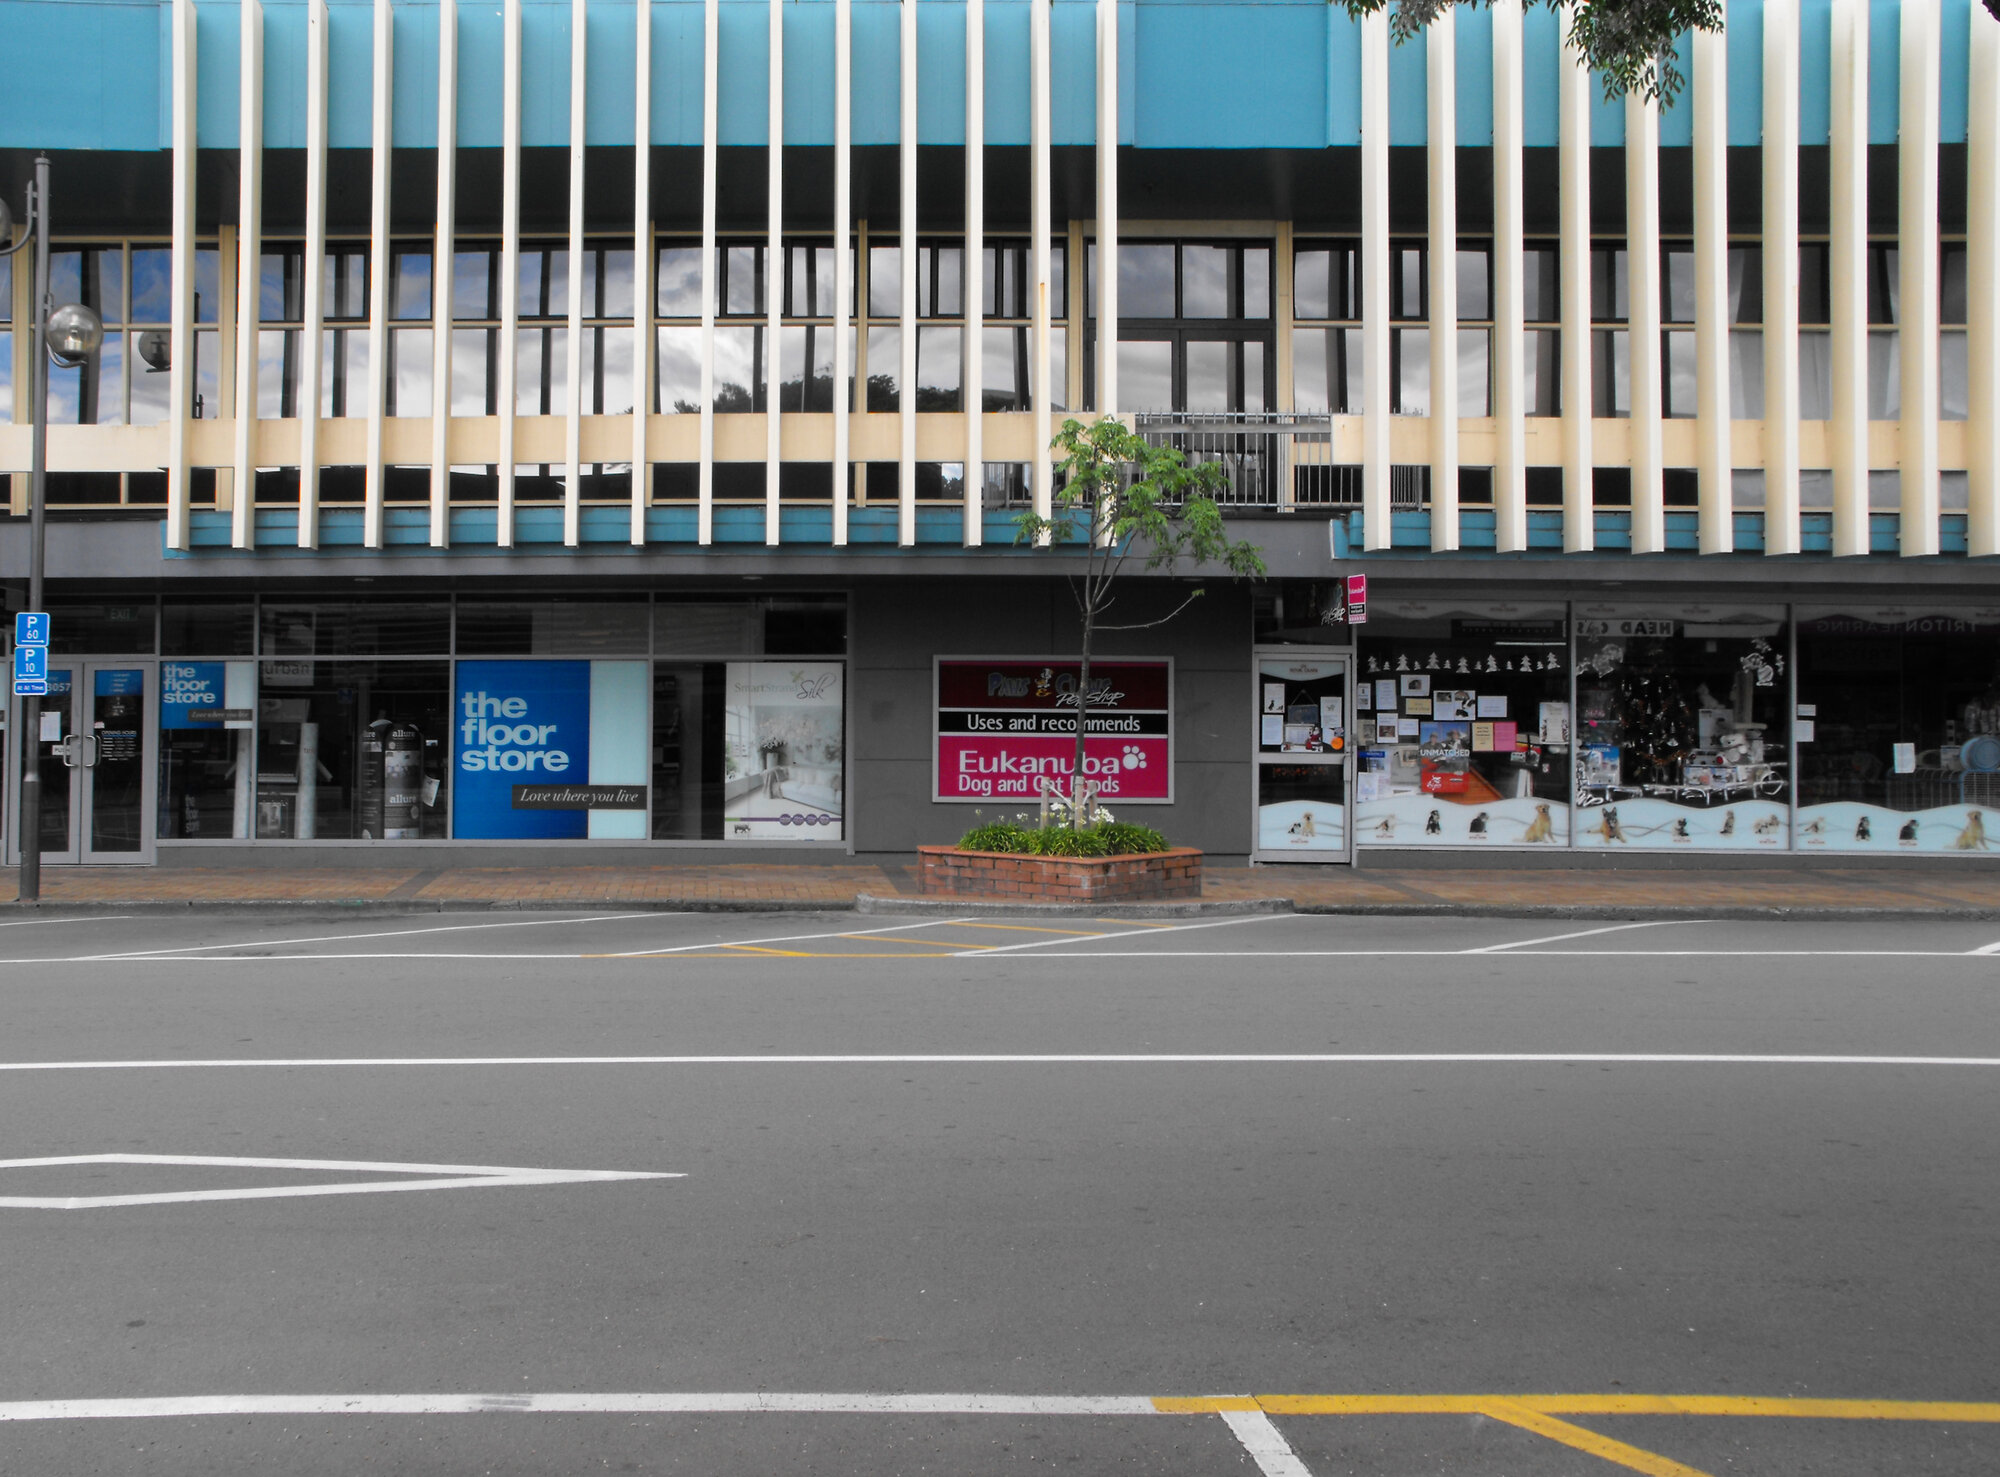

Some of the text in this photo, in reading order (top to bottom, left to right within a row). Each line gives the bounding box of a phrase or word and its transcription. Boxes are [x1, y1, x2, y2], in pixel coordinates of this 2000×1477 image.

[27, 616, 38, 629] P
[26, 629, 39, 640] 60
[25, 649, 36, 662] P
[25, 663, 36, 673] 10
[163, 664, 196, 678] the
[163, 678, 210, 691] floor
[796, 671, 837, 700] Silk
[163, 691, 216, 704] store
[461, 691, 528, 718] the
[967, 714, 1003, 731] Uses
[1009, 714, 1037, 731] and
[392, 730, 416, 738] allure
[461, 718, 557, 746] floor
[461, 745, 570, 772] store
[959, 750, 1120, 774] Eukanuba
[959, 774, 992, 797] Dog
[997, 774, 1027, 792] and
[520, 788, 639, 806] Love where you live
